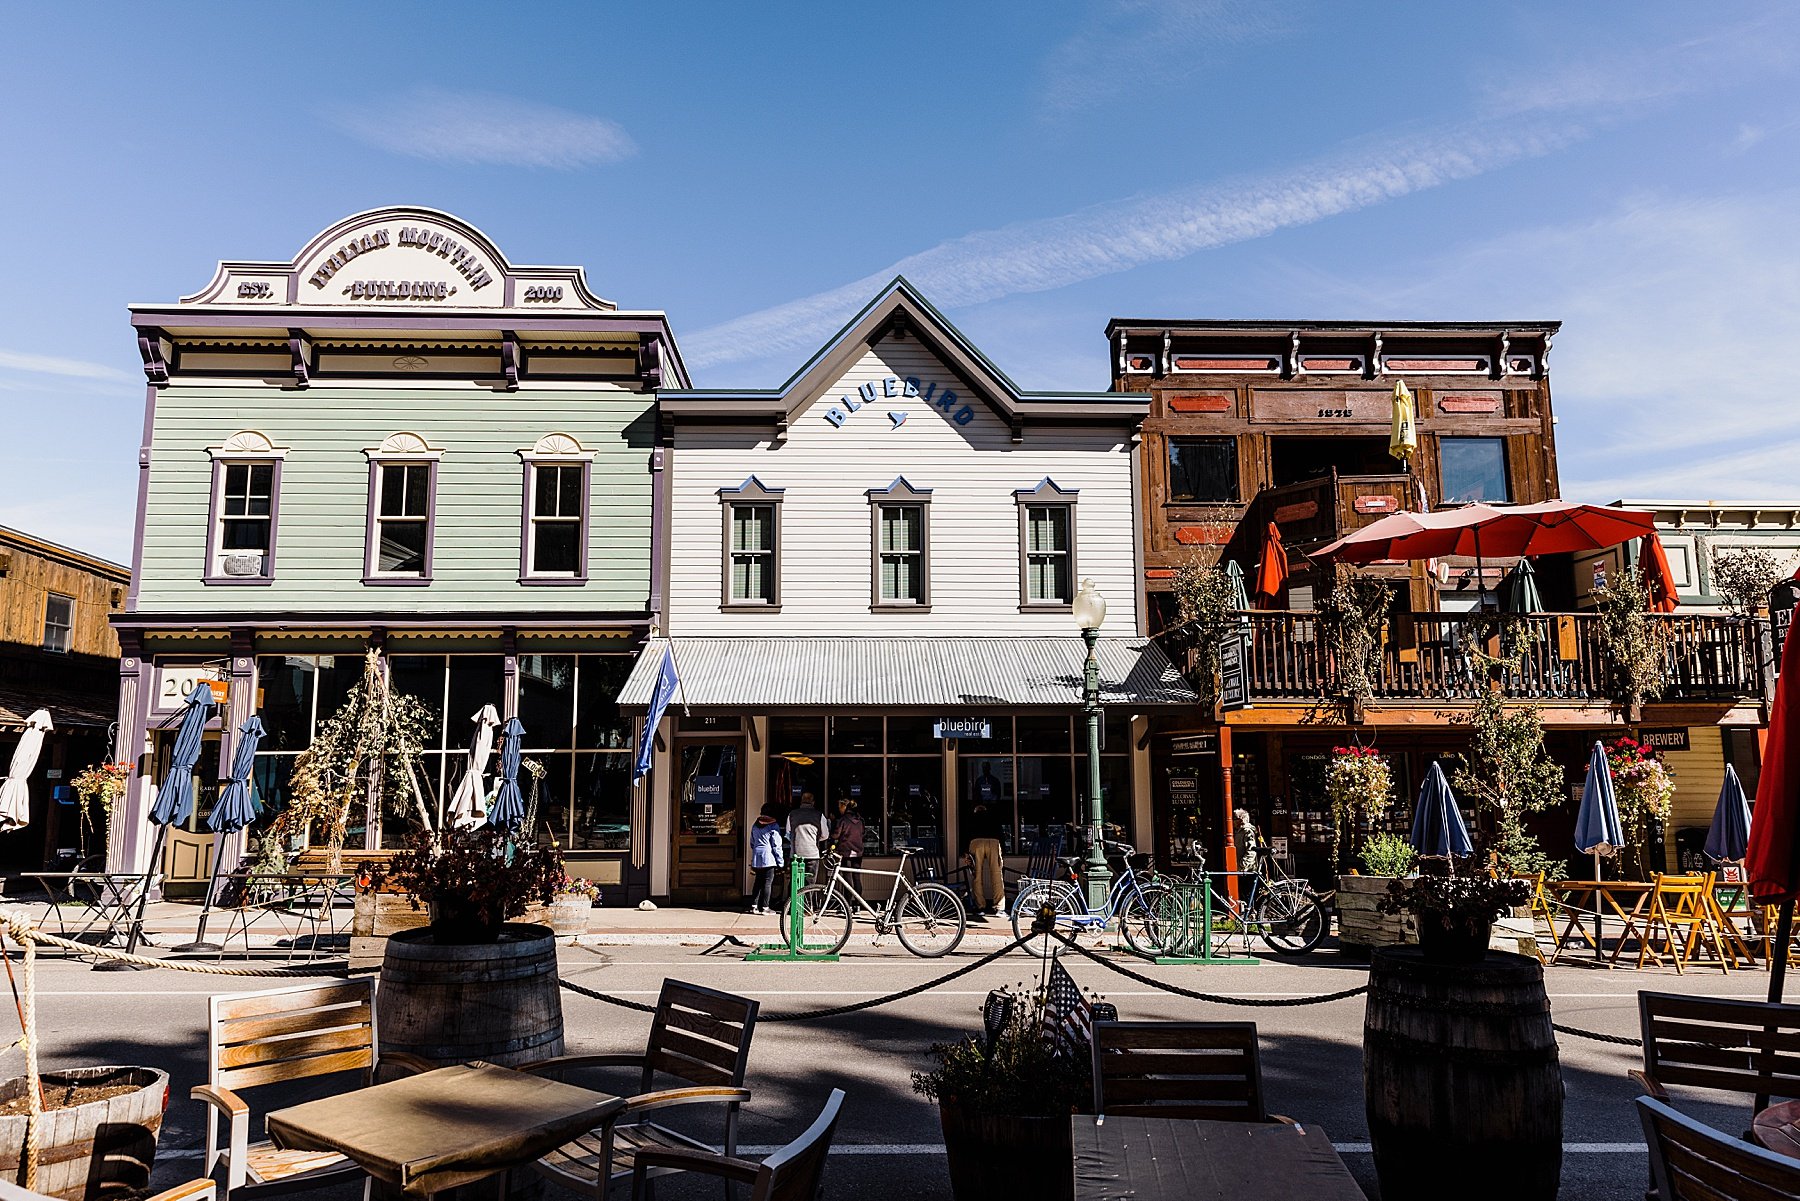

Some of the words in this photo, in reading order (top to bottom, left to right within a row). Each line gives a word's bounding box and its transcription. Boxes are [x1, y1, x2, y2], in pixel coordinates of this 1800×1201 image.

[309, 228, 390, 290] ITALIAN
[399, 227, 493, 291] MOUNTAIN
[238, 281, 274, 297] EST.
[352, 280, 448, 299] BUILDING
[526, 286, 563, 301] 2000
[823, 377, 974, 429] BLUEBIRD
[940, 717, 986, 731] bluebird
[1643, 733, 1685, 746] BREWERY
[698, 785, 720, 793] bluebird
